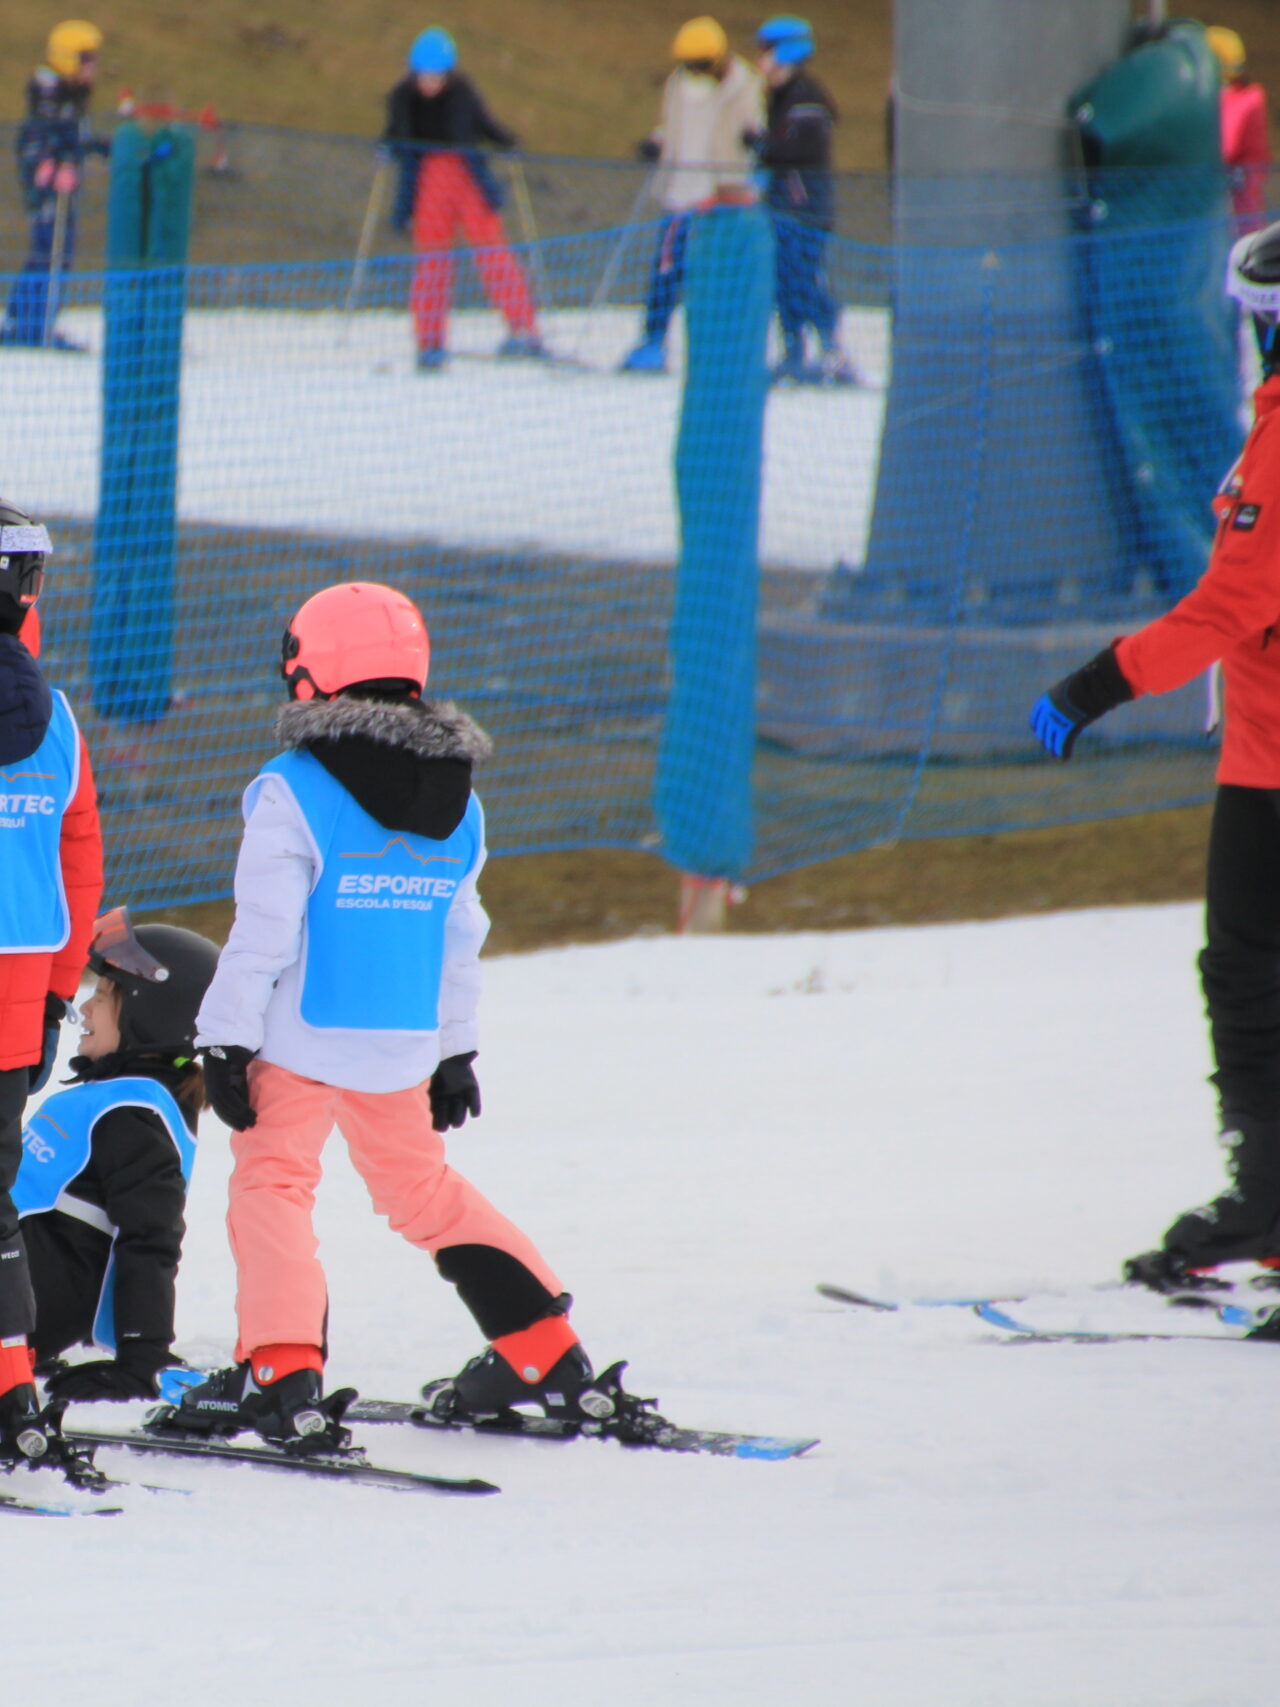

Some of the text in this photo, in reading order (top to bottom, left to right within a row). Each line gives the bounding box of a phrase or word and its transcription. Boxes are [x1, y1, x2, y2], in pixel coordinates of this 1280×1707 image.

[337, 874, 456, 898] ESPORTEC
[335, 898, 390, 909] ESCOLA
[197, 1400, 239, 1412] ATOMIC
